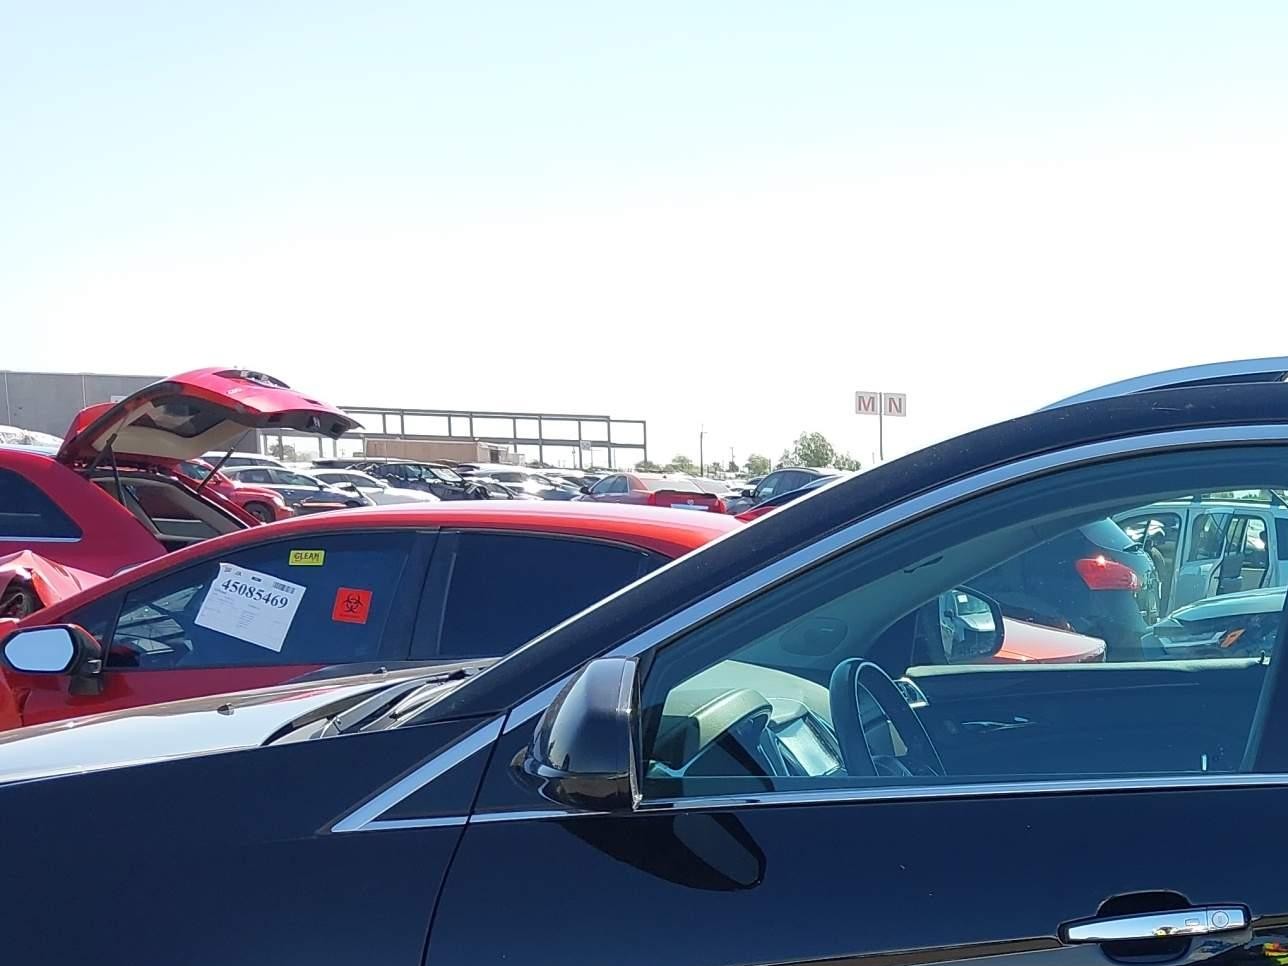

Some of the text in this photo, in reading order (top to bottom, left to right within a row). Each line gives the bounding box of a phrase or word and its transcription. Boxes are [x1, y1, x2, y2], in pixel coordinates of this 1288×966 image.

[858, 395, 902, 414] M N
[221, 579, 289, 609] 45085469
